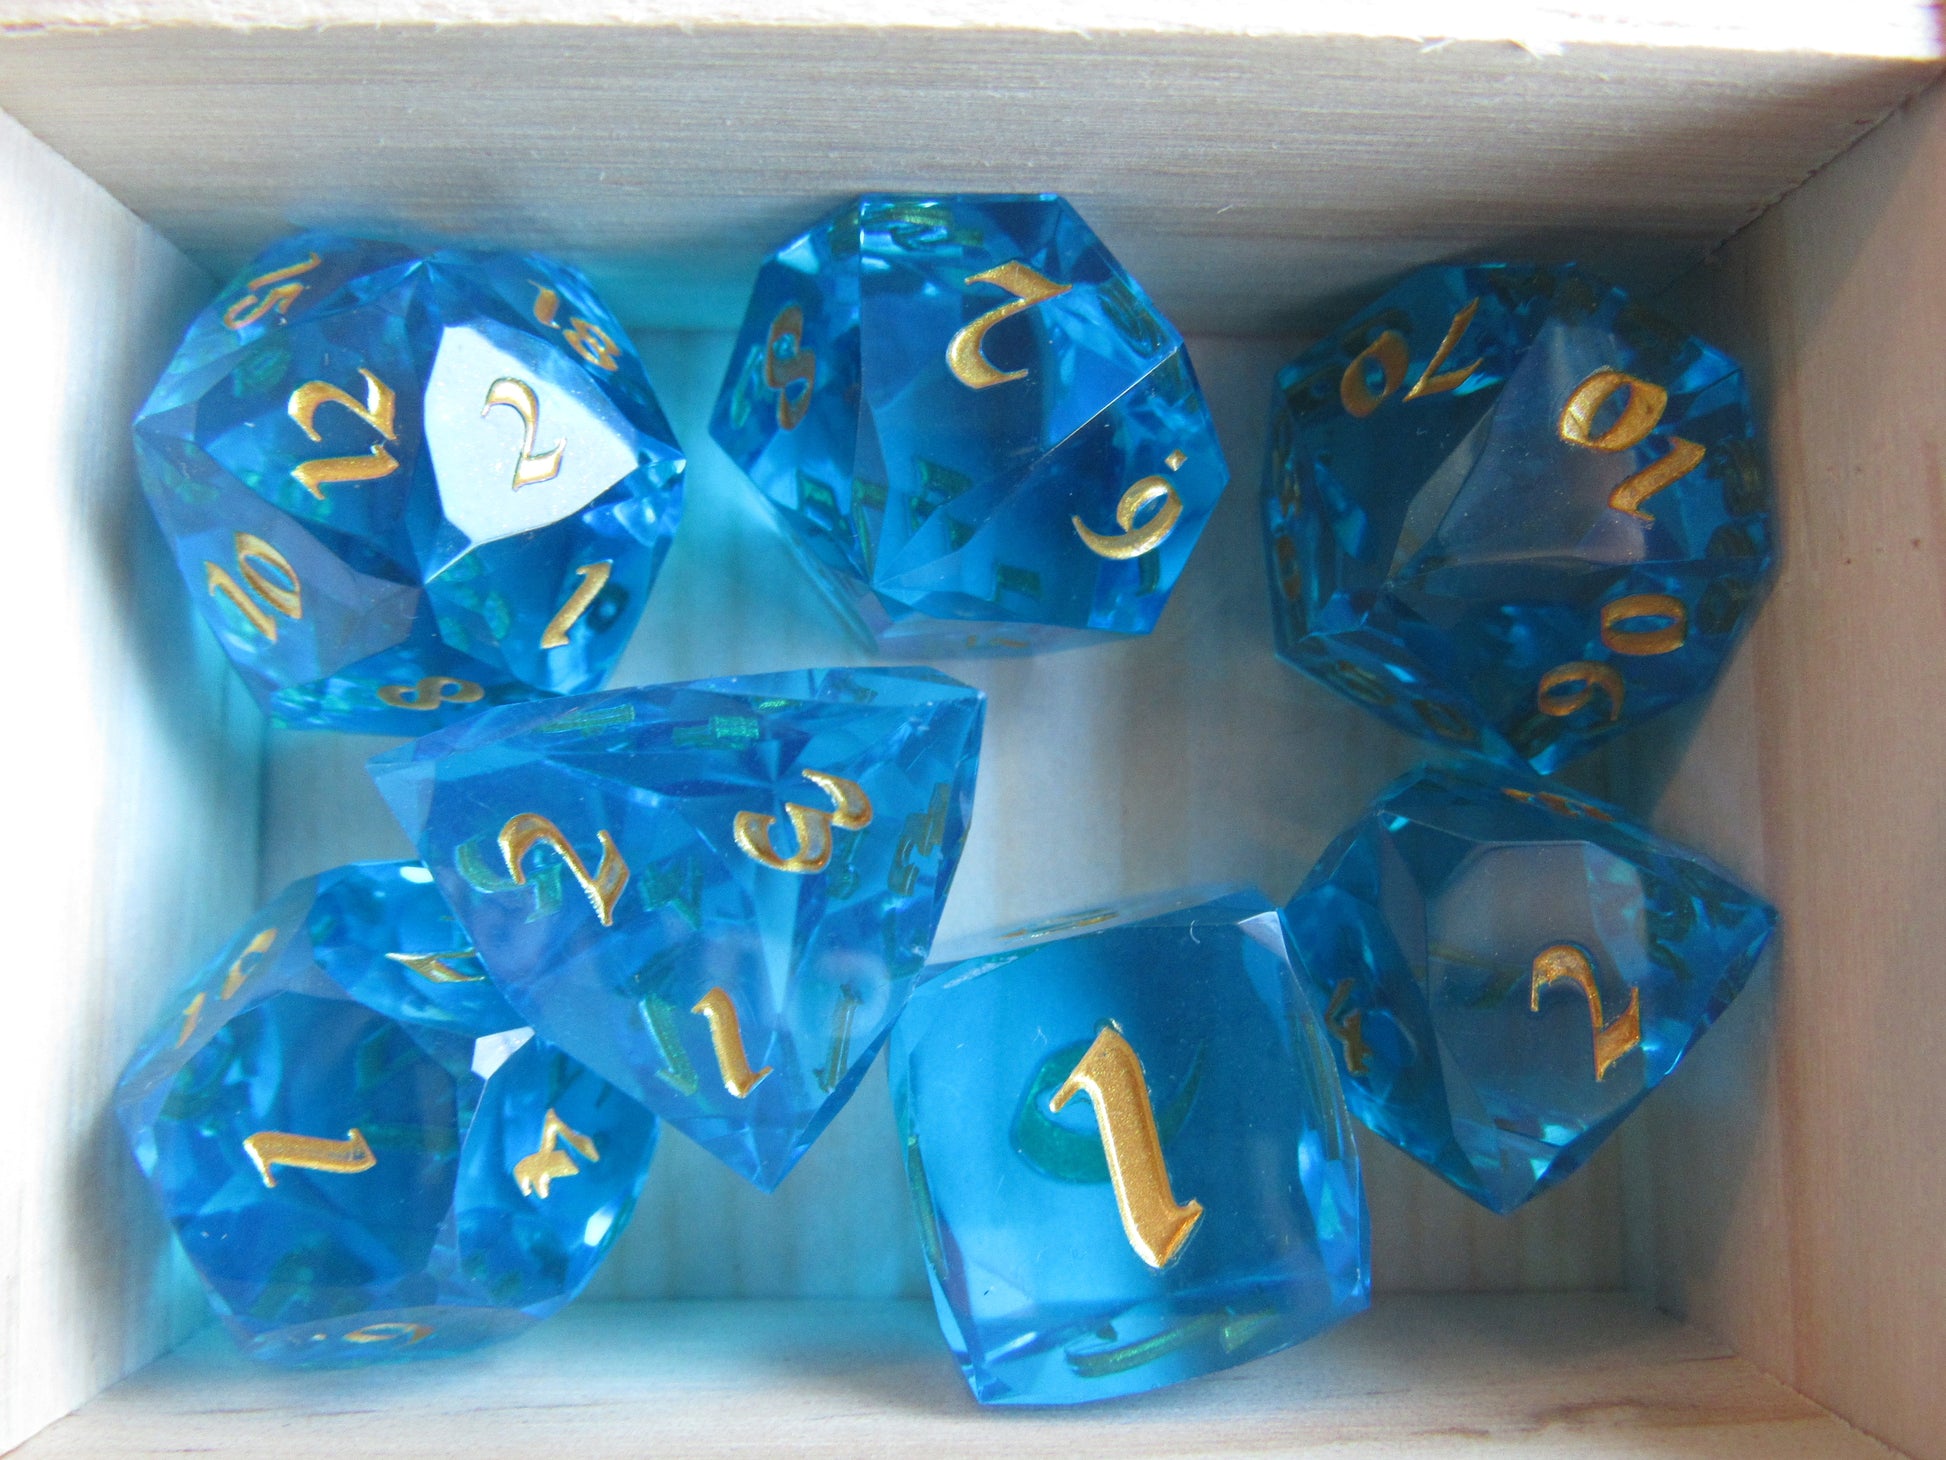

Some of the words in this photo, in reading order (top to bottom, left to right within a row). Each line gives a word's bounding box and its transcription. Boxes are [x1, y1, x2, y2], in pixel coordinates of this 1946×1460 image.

[765, 306, 816, 430] 8
[288, 368, 398, 499] 12
[481, 377, 567, 491] 2
[1559, 367, 1706, 523] 10
[205, 531, 301, 643] 10
[541, 559, 612, 649] 1
[377, 676, 484, 711] 8
[1537, 594, 1686, 721] 90
[498, 813, 629, 926] 2
[733, 769, 872, 873] 3
[691, 986, 774, 1099] 1
[1530, 943, 1641, 1082] 2
[242, 1128, 377, 1188] 1
[1049, 1022, 1204, 1270] 1
